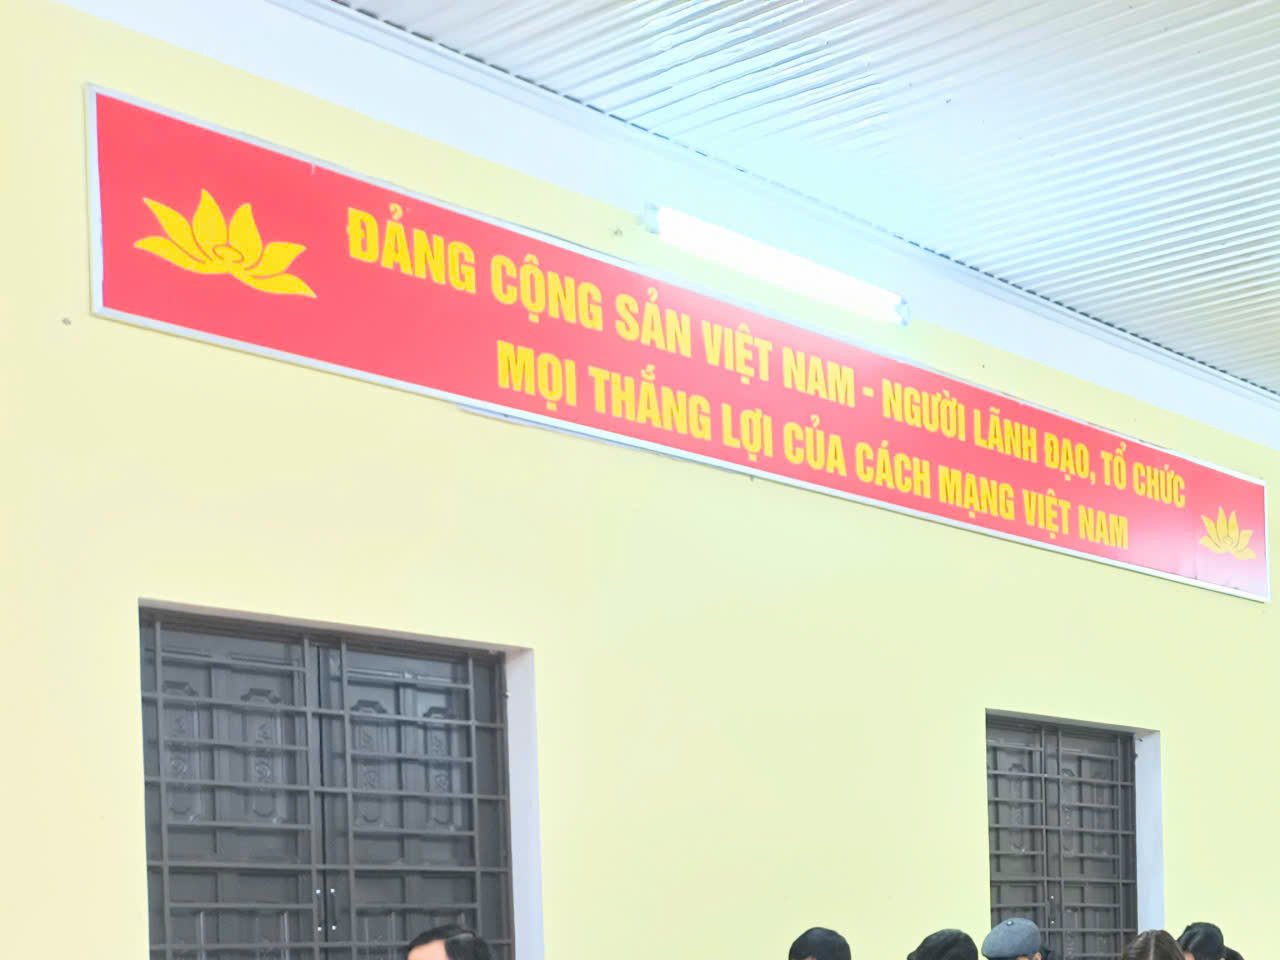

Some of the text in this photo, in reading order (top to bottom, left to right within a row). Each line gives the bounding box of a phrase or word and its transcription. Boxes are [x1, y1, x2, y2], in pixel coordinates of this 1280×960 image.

[347, 203, 477, 294] ĐẢNG
[490, 253, 604, 332] CỘNG
[615, 286, 692, 358] SẢN
[702, 322, 773, 385] VIỆT
[782, 345, 856, 408] NAM
[882, 378, 966, 442] NGƯỜI
[974, 408, 1039, 464] LÃNH
[1044, 432, 1097, 483] ĐẠO,
[1101, 442, 1128, 491] TỔ
[1132, 463, 1187, 509] CHỨC
[496, 339, 1129, 550] MỌI THẮNG LỢI CỦA CÁCH MẠNG VIỆT NAM
